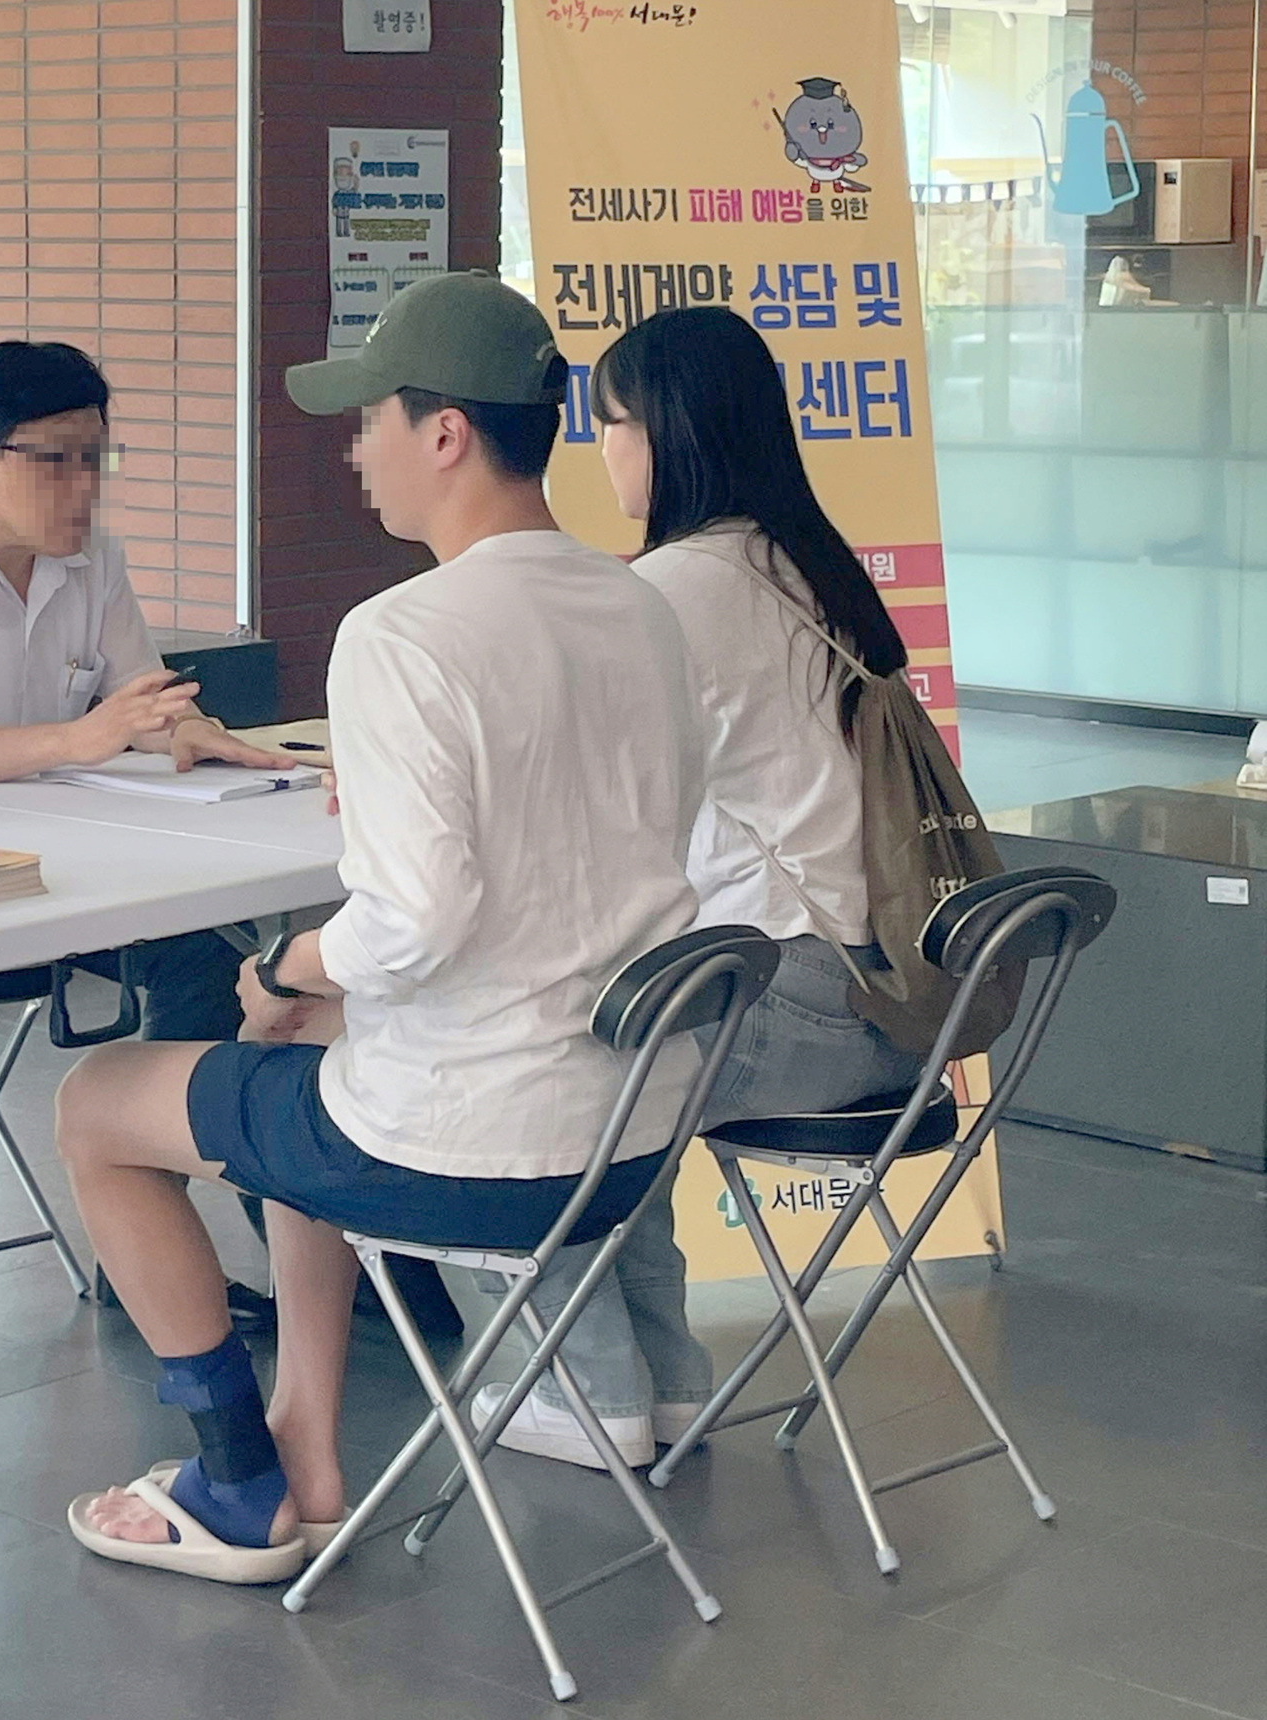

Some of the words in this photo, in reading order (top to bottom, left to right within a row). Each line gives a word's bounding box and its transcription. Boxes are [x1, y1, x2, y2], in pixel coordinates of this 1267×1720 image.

[568, 188, 678, 222] 전세사기
[689, 188, 742, 223] 피해
[752, 189, 824, 223] 예방을
[831, 197, 869, 221] 위한
[750, 263, 837, 329] 상담
[853, 262, 902, 328] 및
[772, 1178, 885, 1213] 서대문
